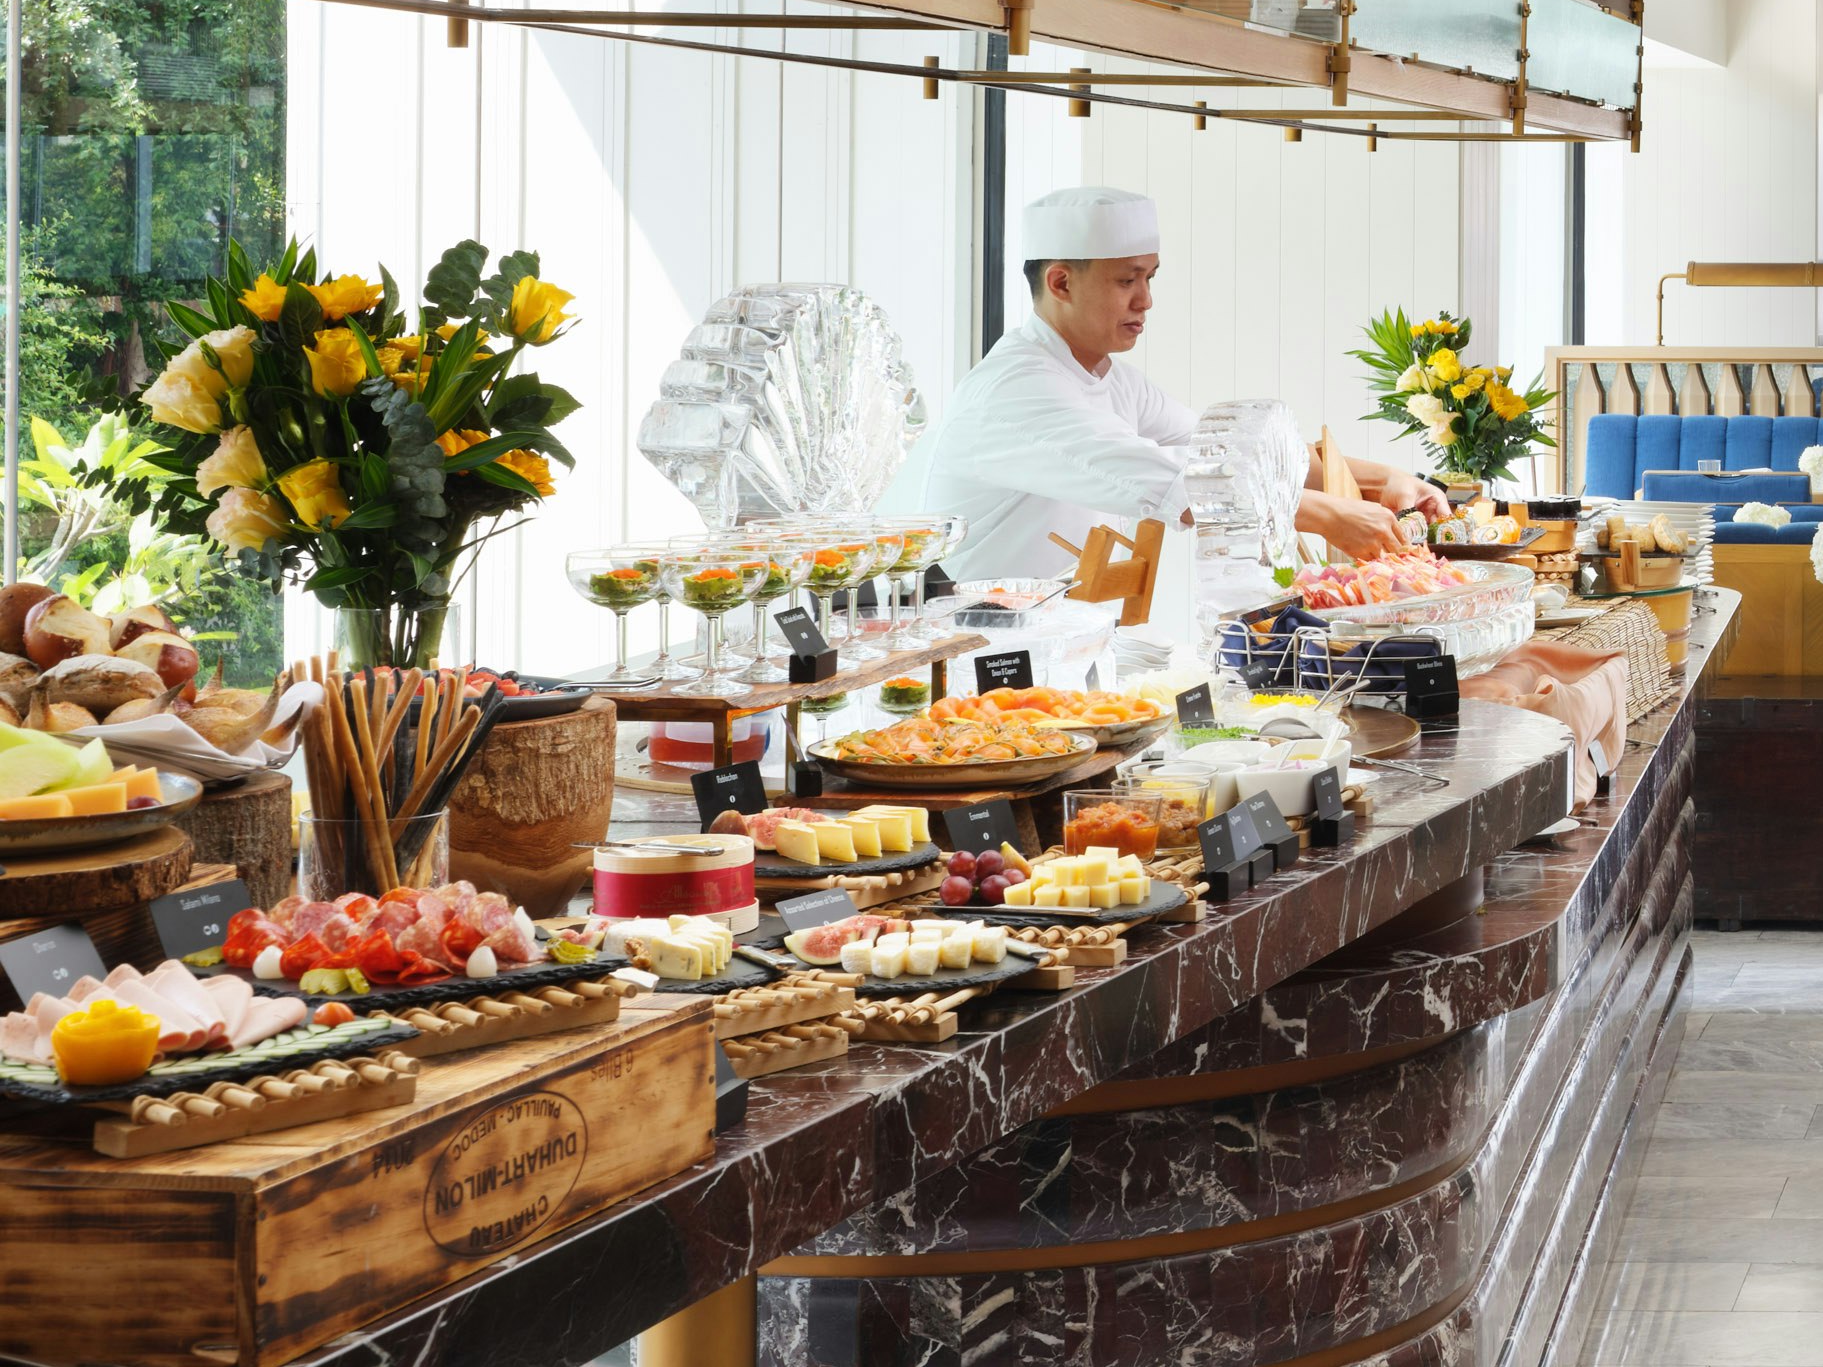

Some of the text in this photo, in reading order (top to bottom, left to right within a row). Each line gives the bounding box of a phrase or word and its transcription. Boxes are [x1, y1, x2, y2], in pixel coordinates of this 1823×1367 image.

[507, 1098, 561, 1124] PAUILLAC
[451, 1118, 497, 1162] MEDOC
[434, 1132, 577, 1215] DUHART-MILON
[469, 1195, 549, 1248] CHATEAU
